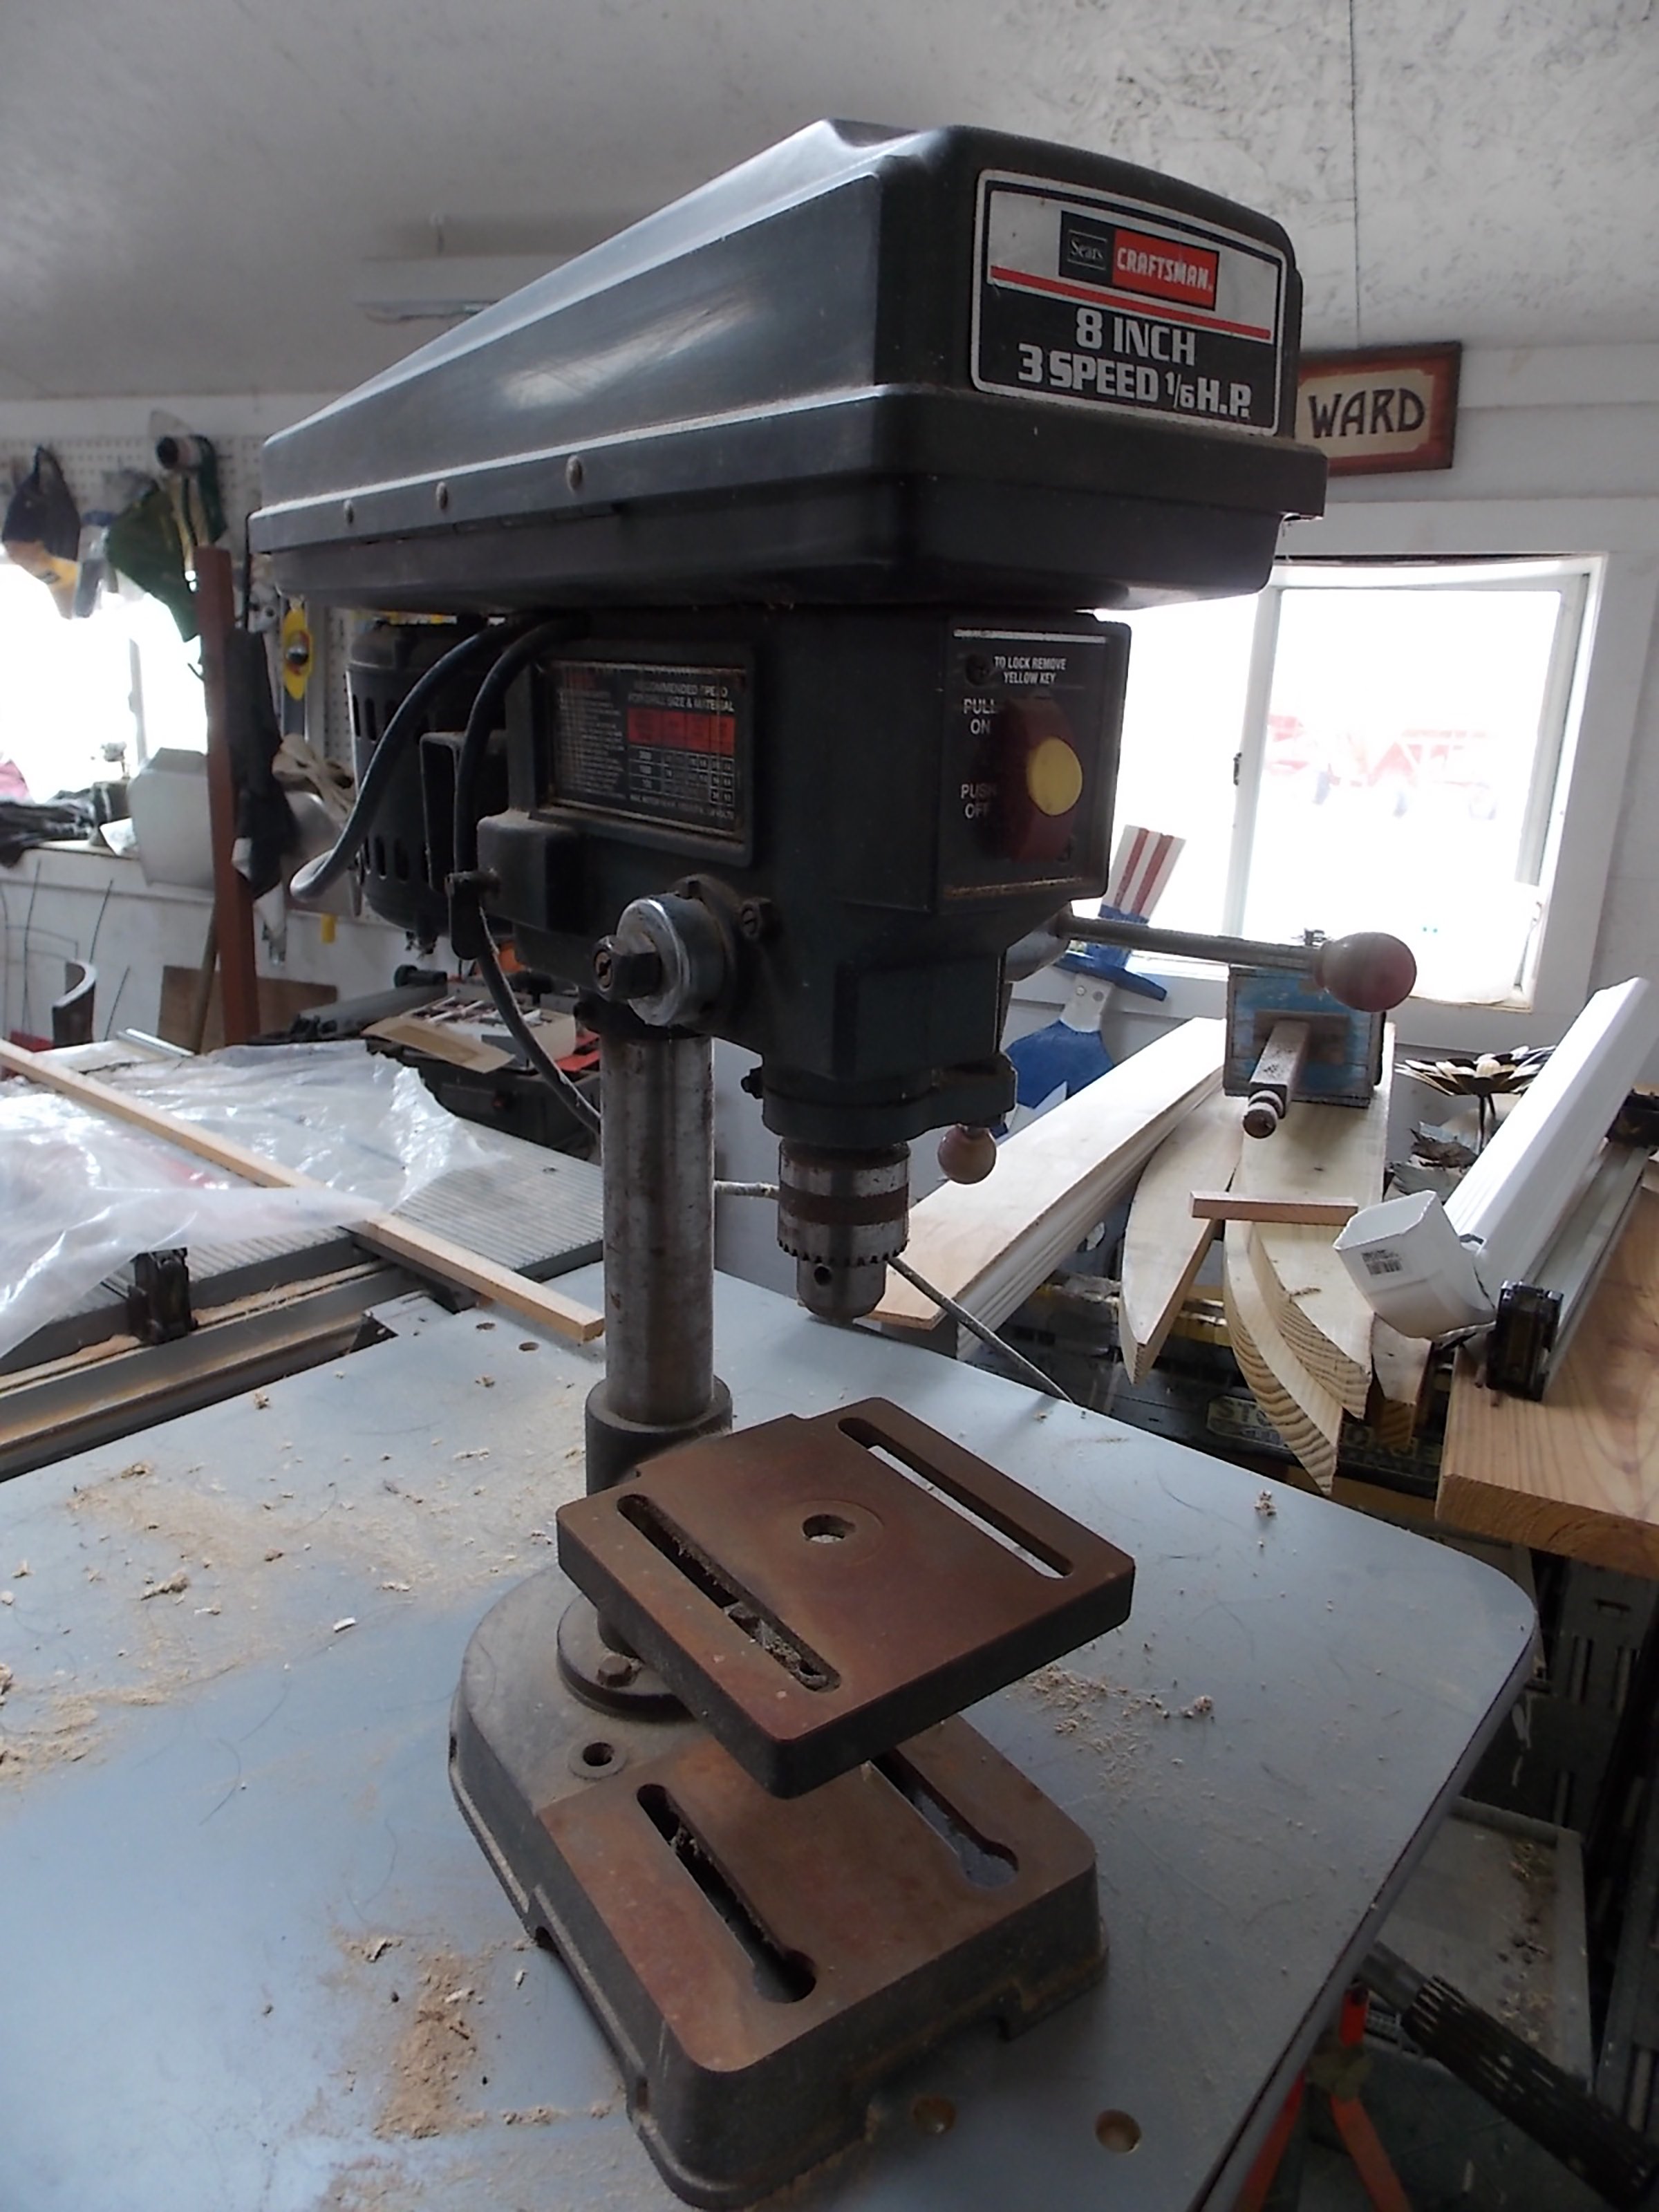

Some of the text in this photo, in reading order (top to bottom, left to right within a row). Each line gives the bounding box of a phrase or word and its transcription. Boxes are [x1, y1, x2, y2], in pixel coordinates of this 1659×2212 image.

[1069, 236, 1210, 291] Sears CRAFTSMAN
[1076, 308, 1196, 366] 8 INCH
[1018, 343, 1042, 384] 3
[1049, 350, 1159, 402] SPEED
[1308, 388, 1425, 439] WARD
[994, 656, 1067, 671] TO LOCK REMOVE
[1003, 671, 1057, 684] YELLOW KEY
[963, 697, 999, 715] PULL
[970, 718, 991, 735] ON
